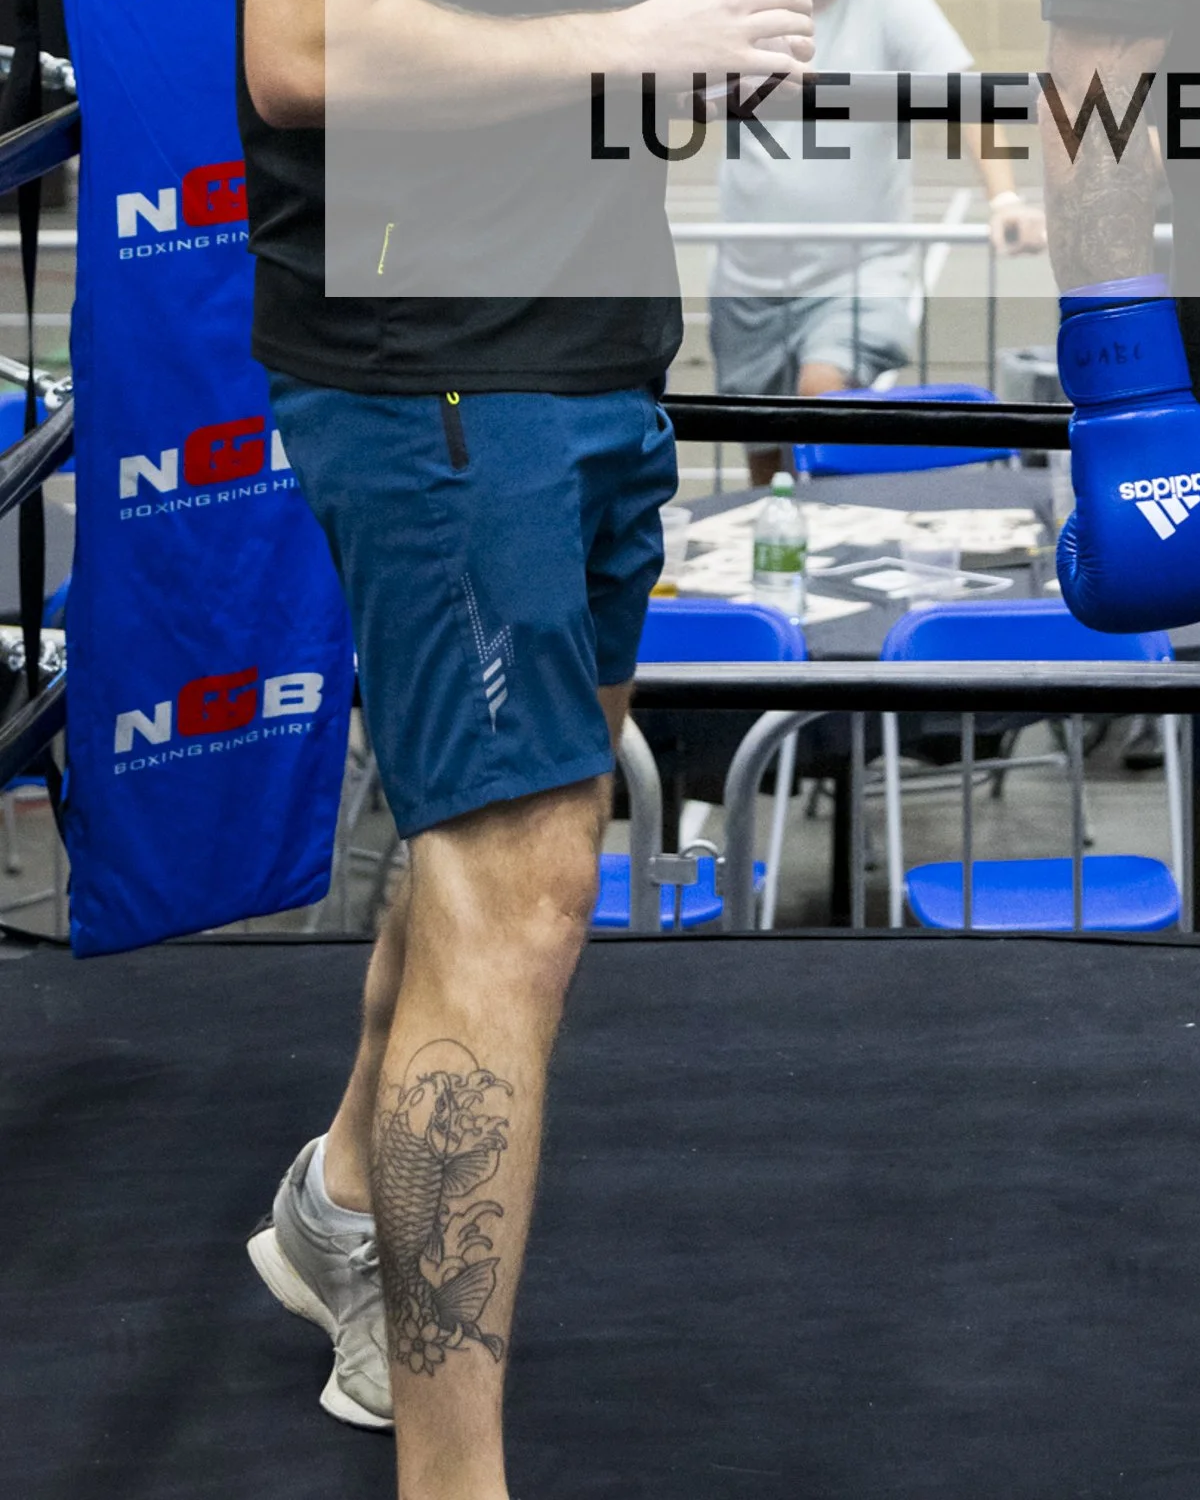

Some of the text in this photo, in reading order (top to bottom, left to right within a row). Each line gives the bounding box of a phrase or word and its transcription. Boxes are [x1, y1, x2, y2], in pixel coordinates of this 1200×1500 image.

[119, 231, 250, 261] BOXING RIN
[119, 494, 211, 521] BOXING
[217, 483, 268, 504] RING
[114, 665, 324, 754] NGB
[114, 744, 204, 775] BOXING
[209, 731, 259, 753] RING
